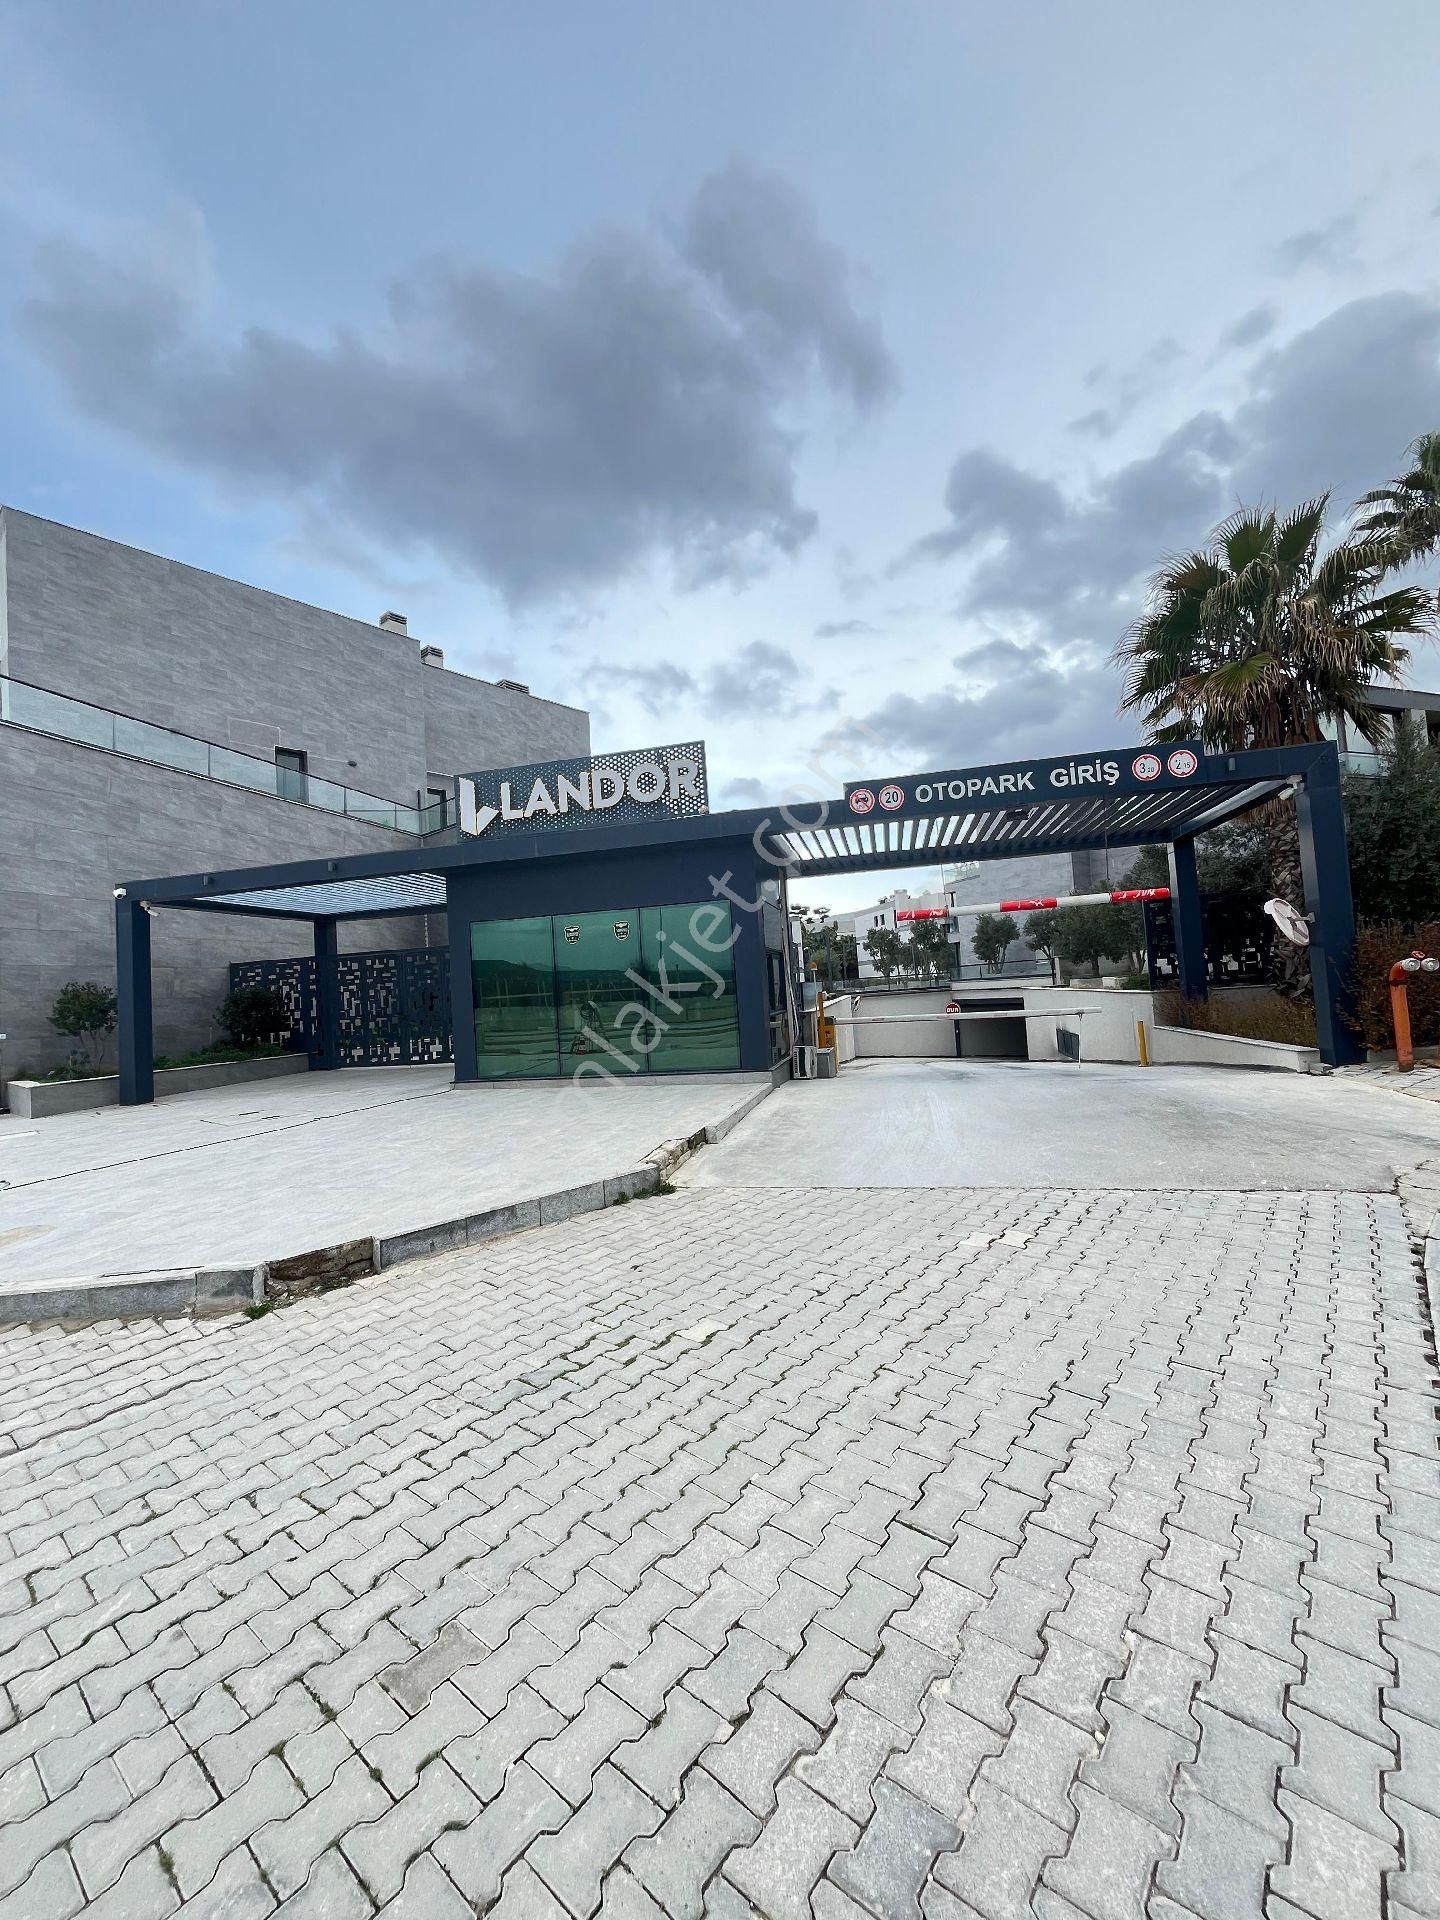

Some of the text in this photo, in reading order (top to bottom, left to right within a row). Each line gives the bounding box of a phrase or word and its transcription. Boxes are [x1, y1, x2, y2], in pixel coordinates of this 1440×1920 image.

[500, 758, 700, 822] LANDOR
[884, 791, 898, 804] 20
[915, 759, 1121, 803] OTOPARK GİRİŞ
